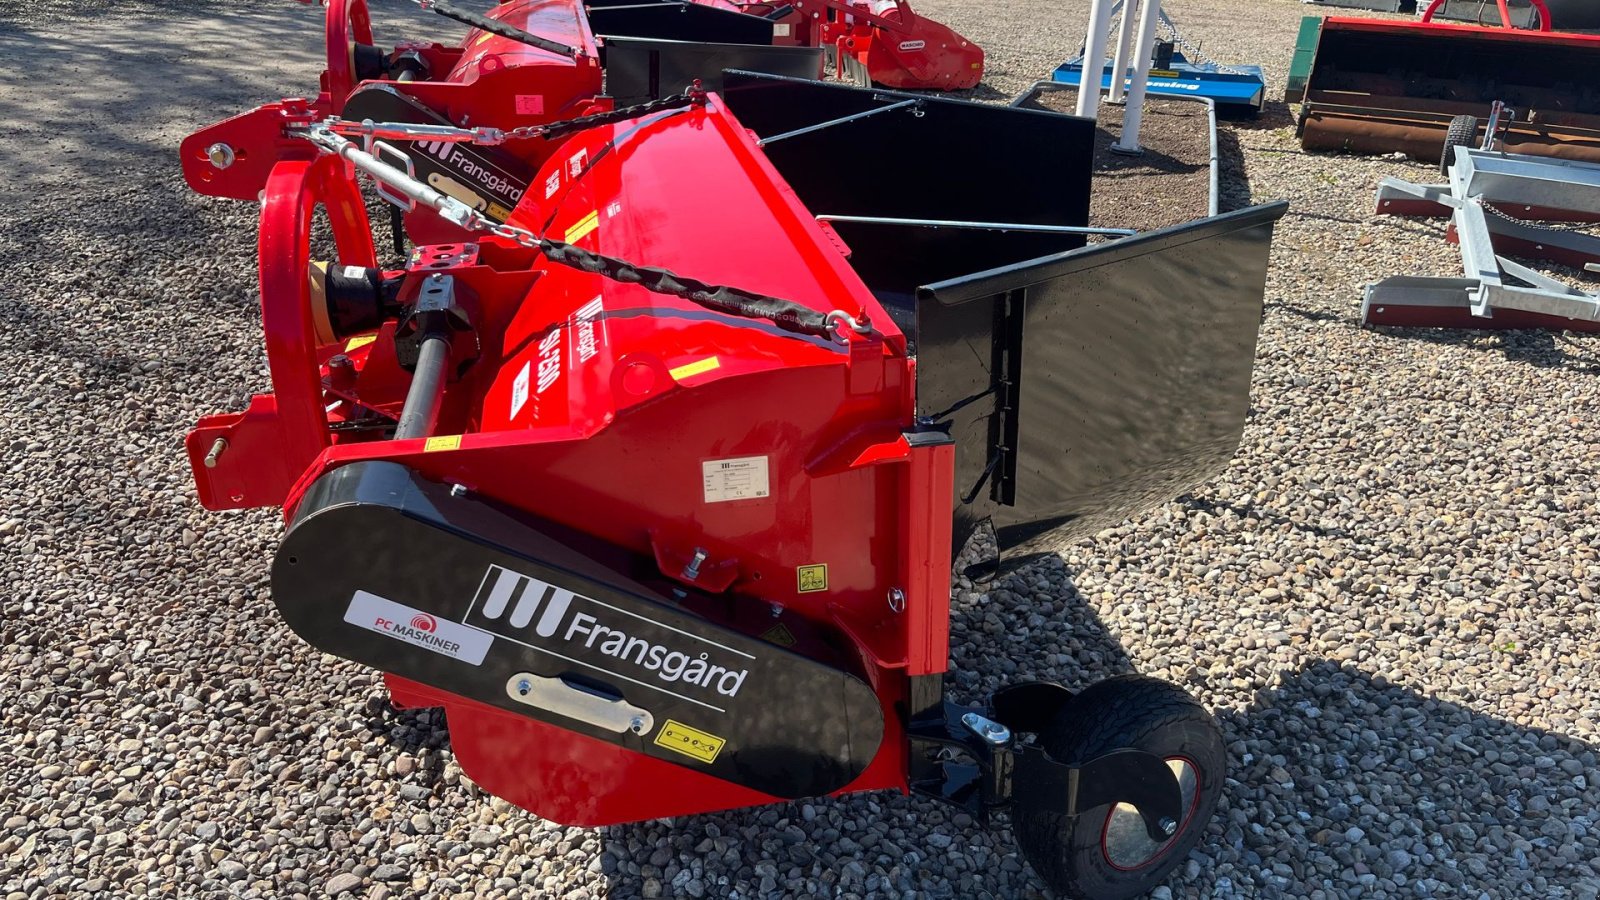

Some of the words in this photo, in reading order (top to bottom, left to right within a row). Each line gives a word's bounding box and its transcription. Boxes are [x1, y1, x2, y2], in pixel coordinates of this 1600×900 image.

[449, 150, 524, 202] Fransgård
[375, 617, 393, 631] PC
[392, 623, 460, 653] MASKINER
[564, 611, 749, 698] Fransgård
